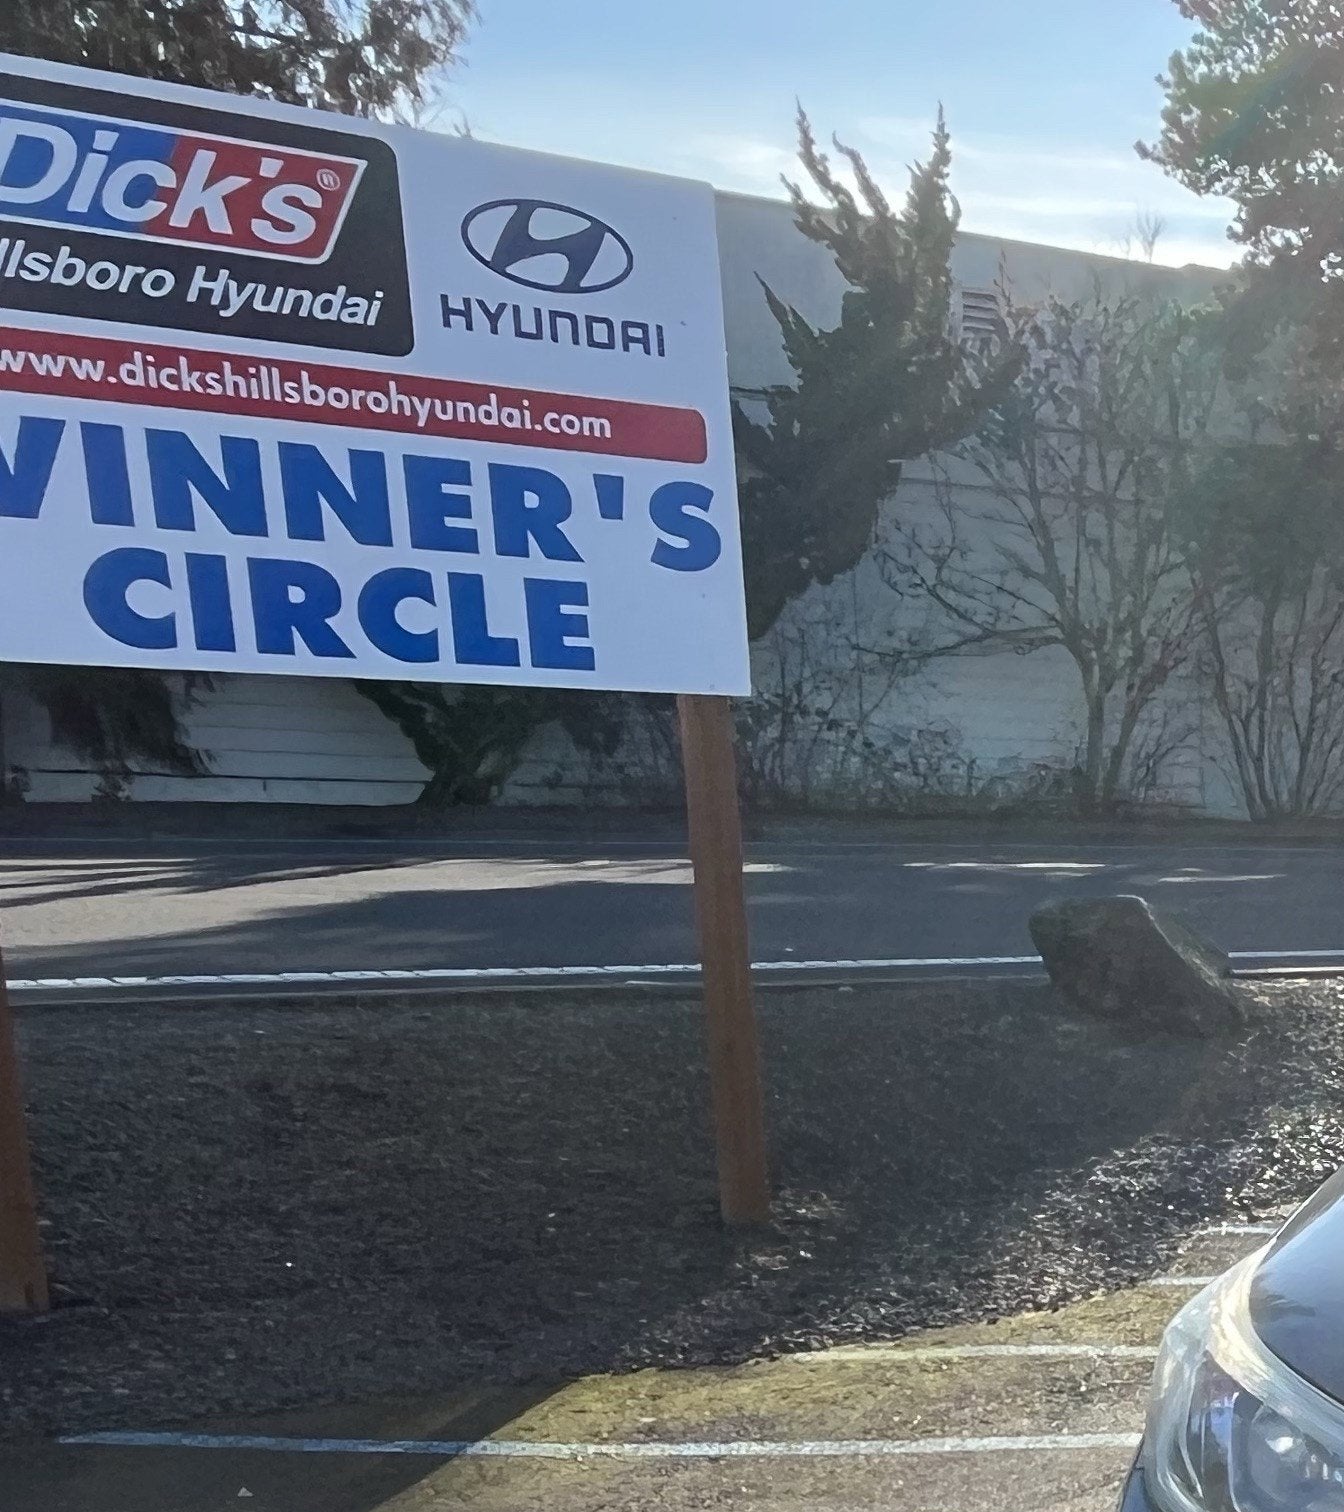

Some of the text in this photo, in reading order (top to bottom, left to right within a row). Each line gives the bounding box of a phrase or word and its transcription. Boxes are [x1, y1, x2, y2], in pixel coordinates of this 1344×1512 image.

[187, 265, 384, 326] Hyundai
[439, 293, 666, 358] HYUNDAI
[82, 546, 597, 671] CIRCLE
